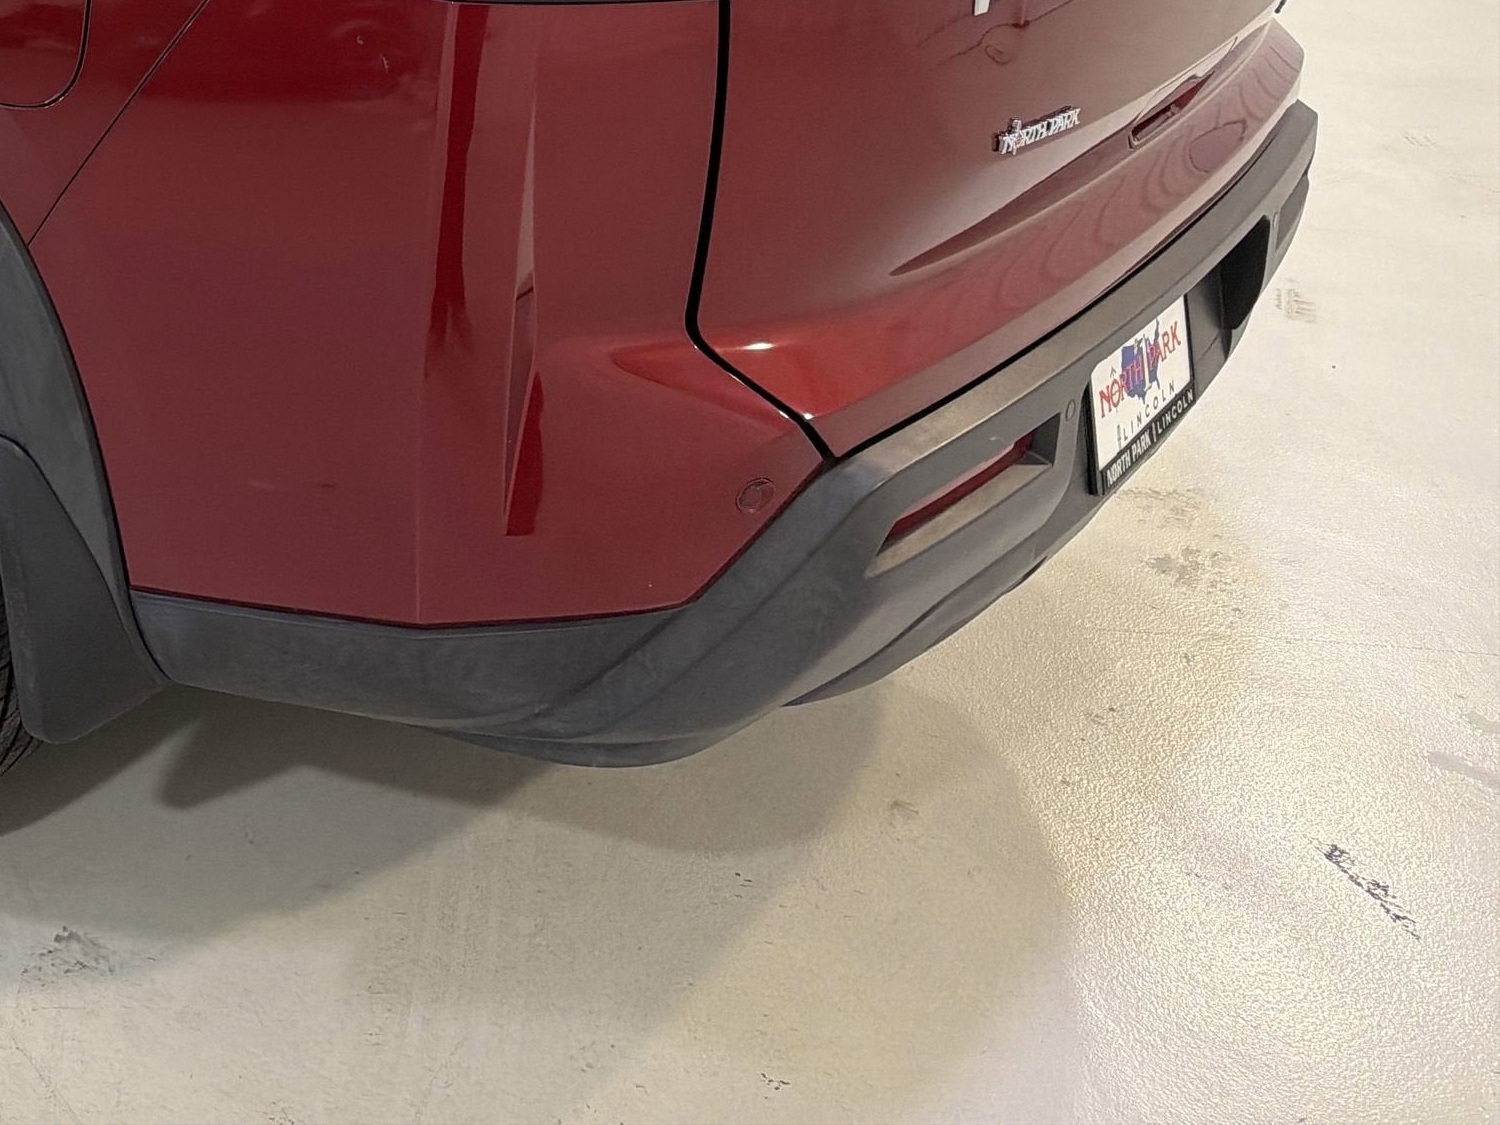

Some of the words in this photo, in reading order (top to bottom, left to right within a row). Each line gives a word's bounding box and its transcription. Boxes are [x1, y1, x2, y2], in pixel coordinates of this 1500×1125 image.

[1048, 108, 1081, 135] PARK
[1098, 354, 1144, 419] NORTH
[1148, 321, 1182, 372] PARK
[1106, 449, 1132, 488] NORTH
[1131, 428, 1152, 462] PARK
[1156, 388, 1194, 434] LINCOLN
[1123, 380, 1175, 441] LINCOLN
